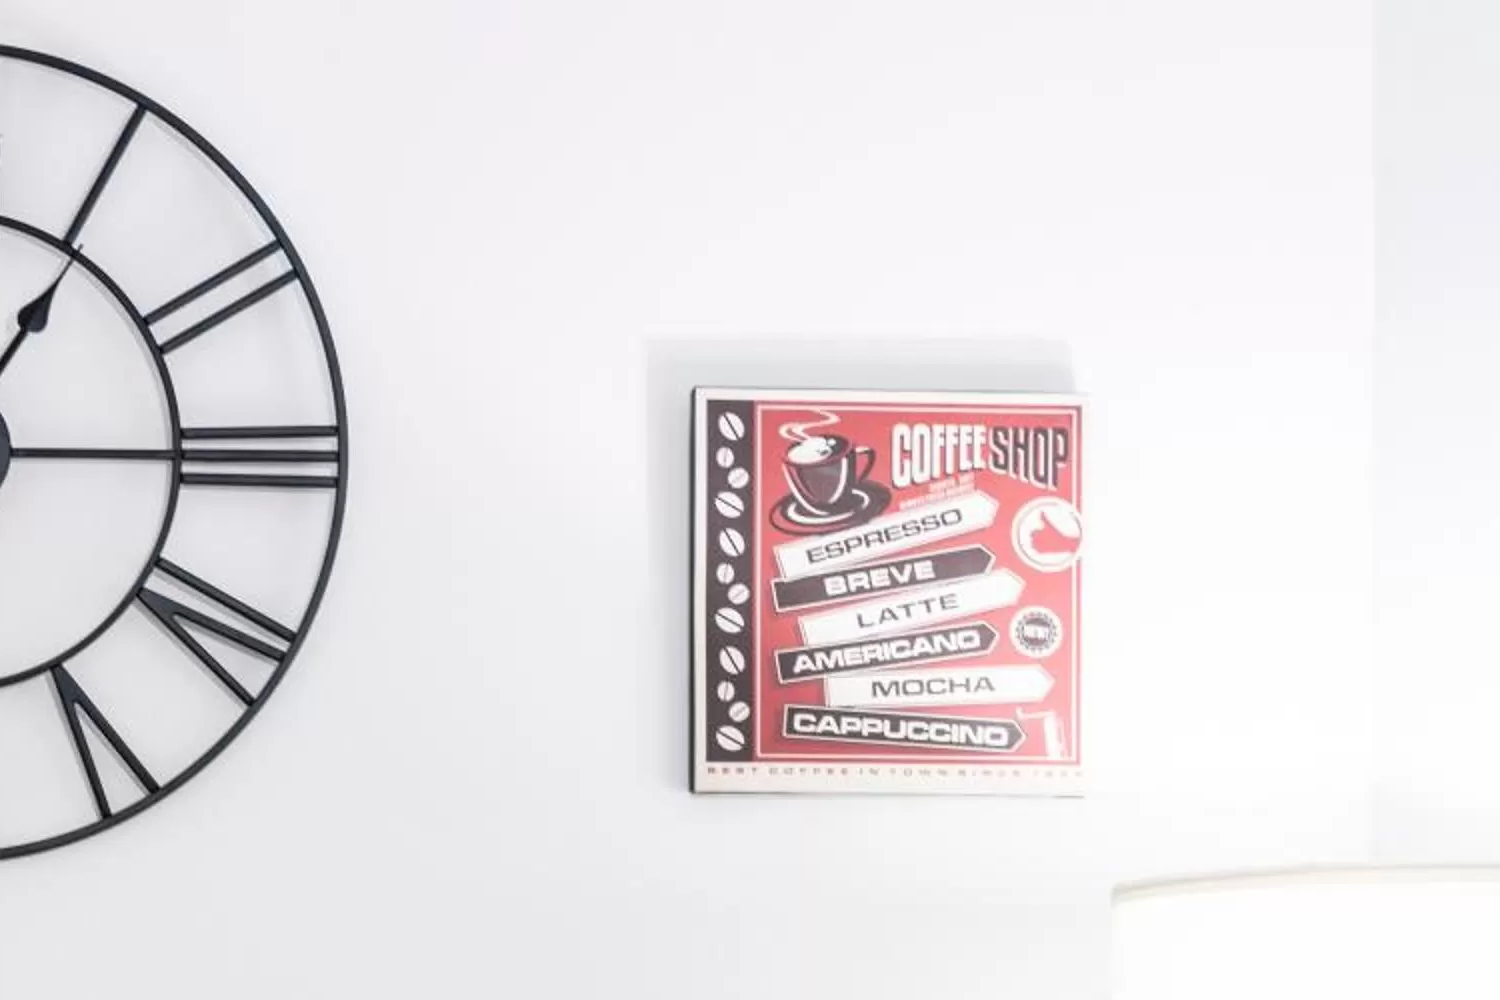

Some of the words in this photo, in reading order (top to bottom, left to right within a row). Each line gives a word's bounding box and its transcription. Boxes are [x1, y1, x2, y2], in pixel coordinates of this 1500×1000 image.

[62, 103, 147, 244] I
[143, 240, 299, 354] II
[180, 425, 340, 489] III
[892, 423, 987, 487] COFFEE
[988, 425, 1069, 491] SHOP
[806, 508, 963, 564] ESPRESSO
[823, 560, 937, 597] BREVE
[133, 556, 298, 708] IV
[856, 593, 960, 630] LATTE
[792, 629, 982, 675] AMERICANO
[871, 675, 996, 699] MOCHA
[792, 712, 1011, 747] CAPPUCCINO
